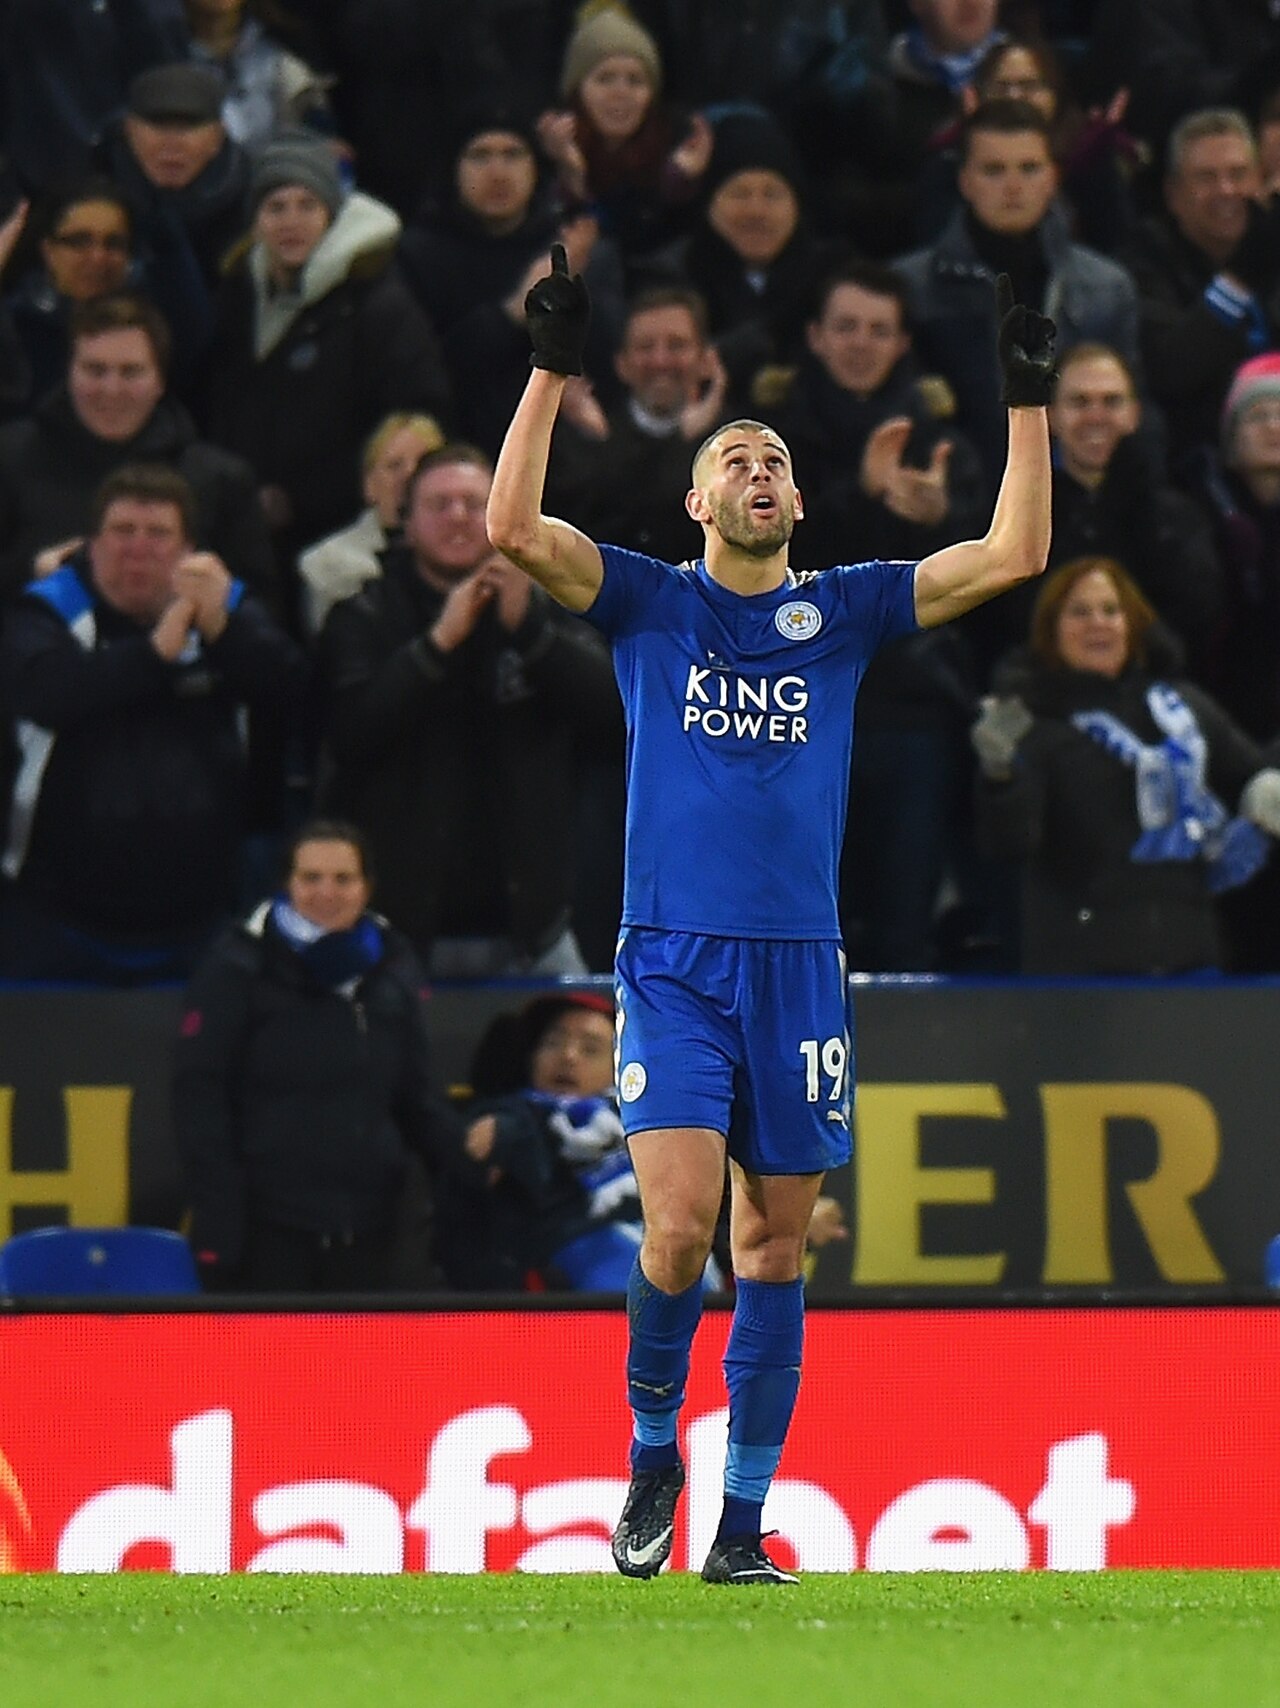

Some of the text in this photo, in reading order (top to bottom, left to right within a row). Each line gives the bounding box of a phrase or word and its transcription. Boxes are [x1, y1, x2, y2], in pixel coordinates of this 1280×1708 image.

[685, 664, 809, 712] KING
[683, 704, 808, 743] POWER
[799, 1037, 845, 1102] 19
[850, 1082, 1226, 1286] ER
[56, 1402, 1136, 1575] dafabet
